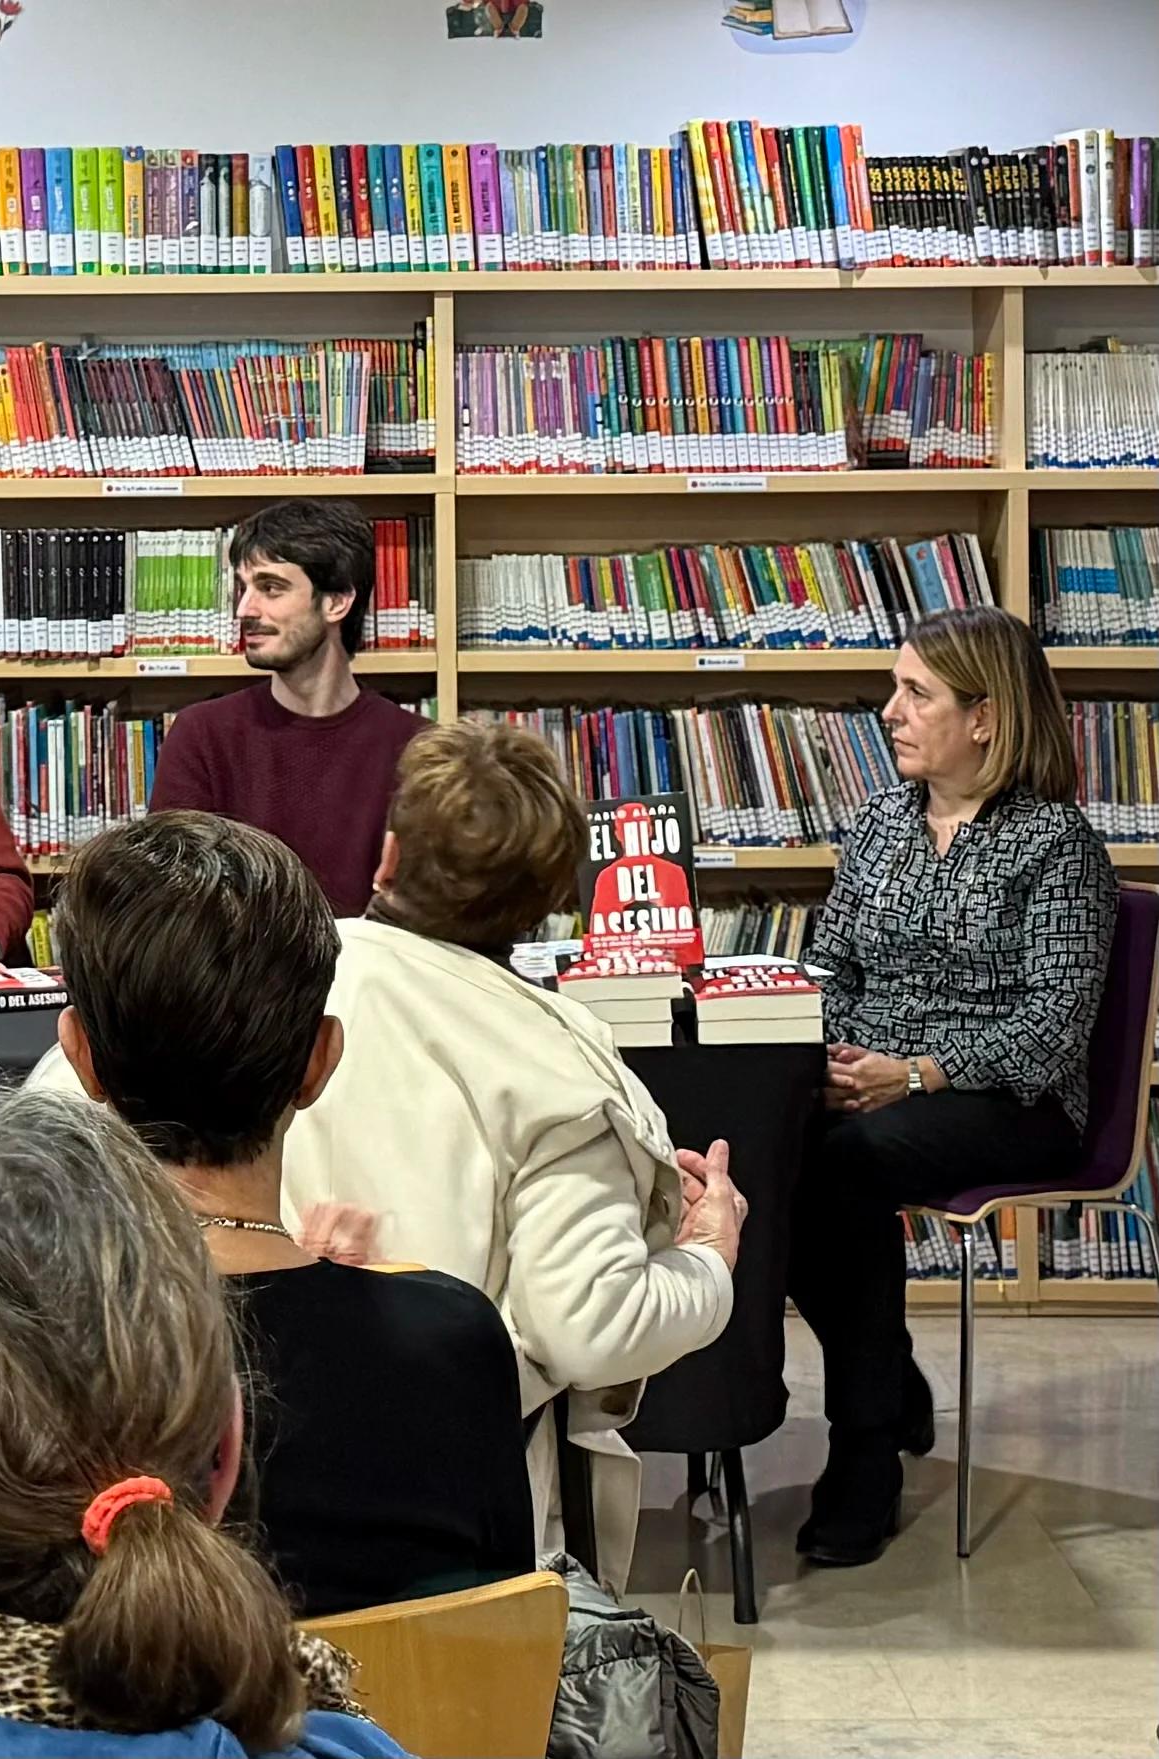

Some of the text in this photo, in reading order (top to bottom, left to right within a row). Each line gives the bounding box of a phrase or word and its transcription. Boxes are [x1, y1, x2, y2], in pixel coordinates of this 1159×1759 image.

[590, 818, 681, 861] EL HIJO
[617, 864, 661, 902] DEL
[594, 906, 693, 940] ASESINO
[8, 994, 26, 1008] DEL
[29, 992, 68, 1006] ASESINO
